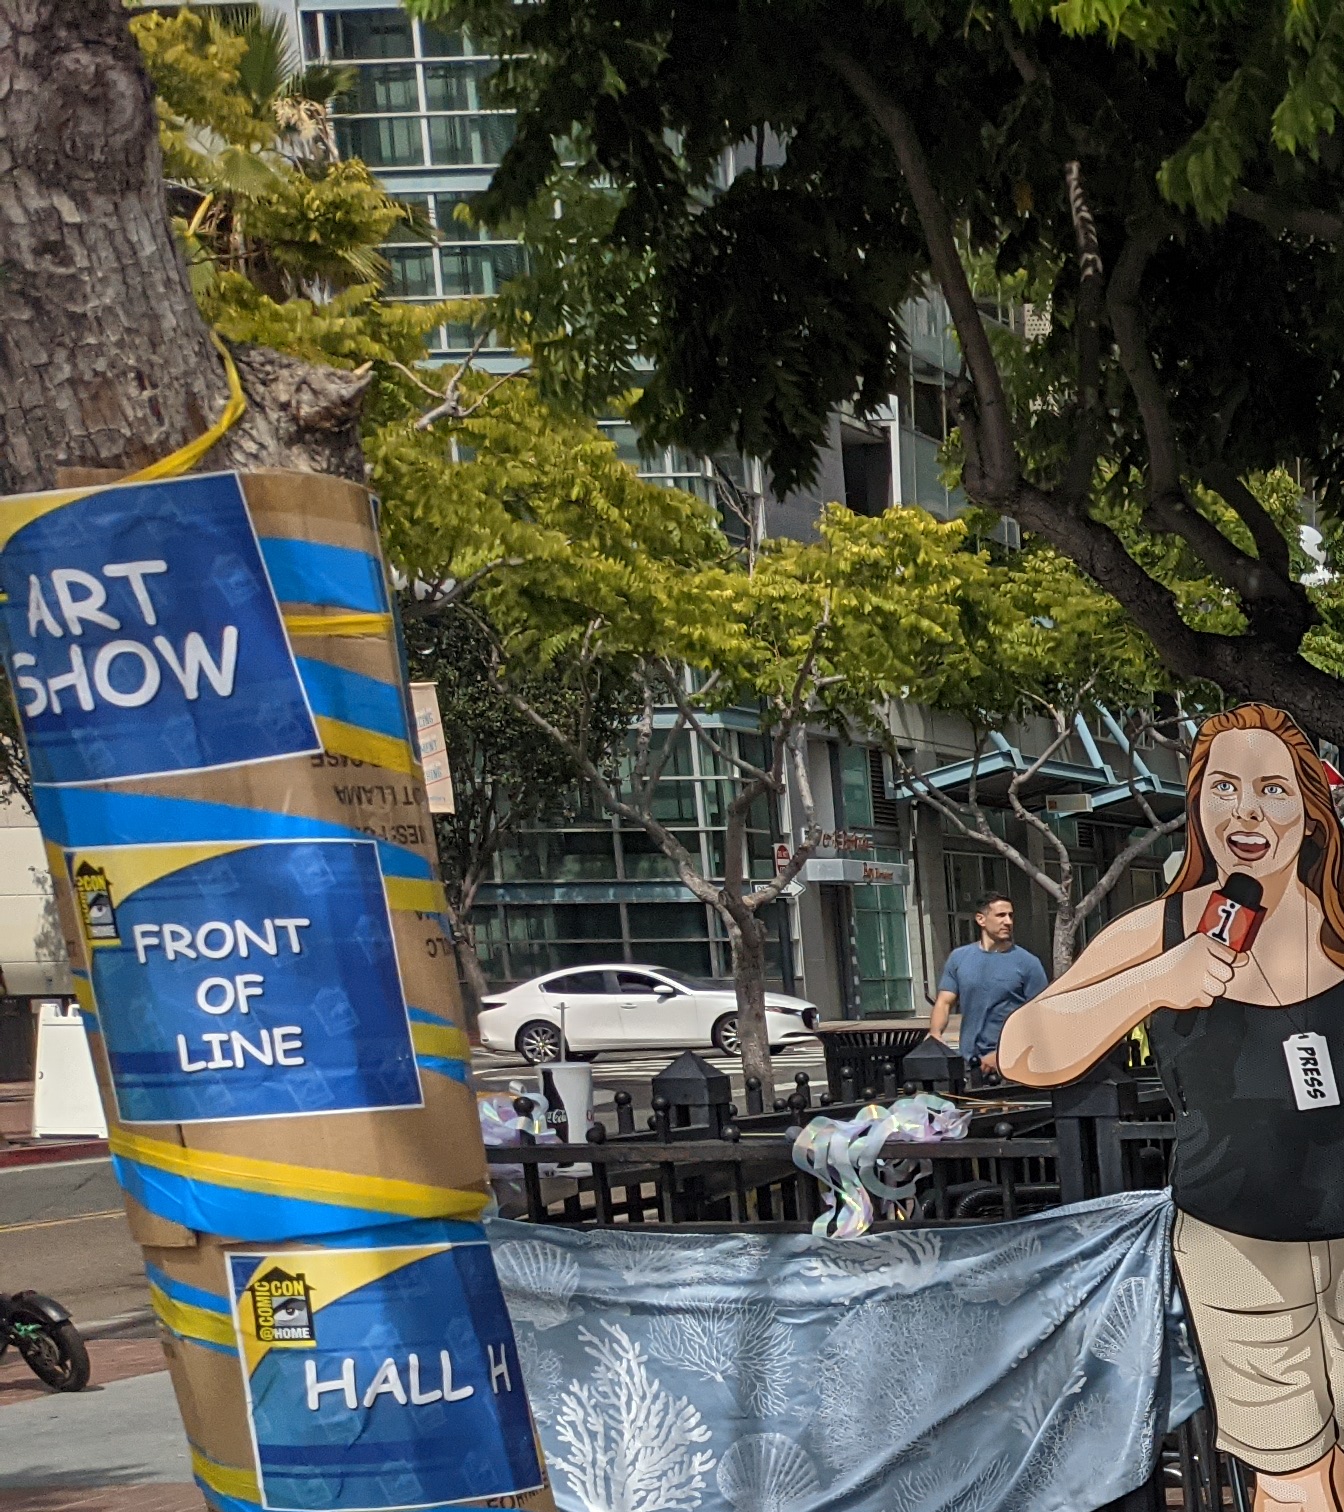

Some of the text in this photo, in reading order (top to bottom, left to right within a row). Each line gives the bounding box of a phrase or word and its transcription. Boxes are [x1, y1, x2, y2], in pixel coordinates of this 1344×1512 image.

[28, 560, 167, 637] ART
[13, 625, 238, 717] SHOW
[133, 917, 310, 963] FRONT
[196, 973, 264, 1016] OF
[177, 1026, 305, 1073] LINE
[1296, 1045, 1327, 1101] PRESS
[254, 1280, 275, 1326] COMIC
[271, 1280, 304, 1296] CON
[305, 1344, 513, 1412] HALL H
